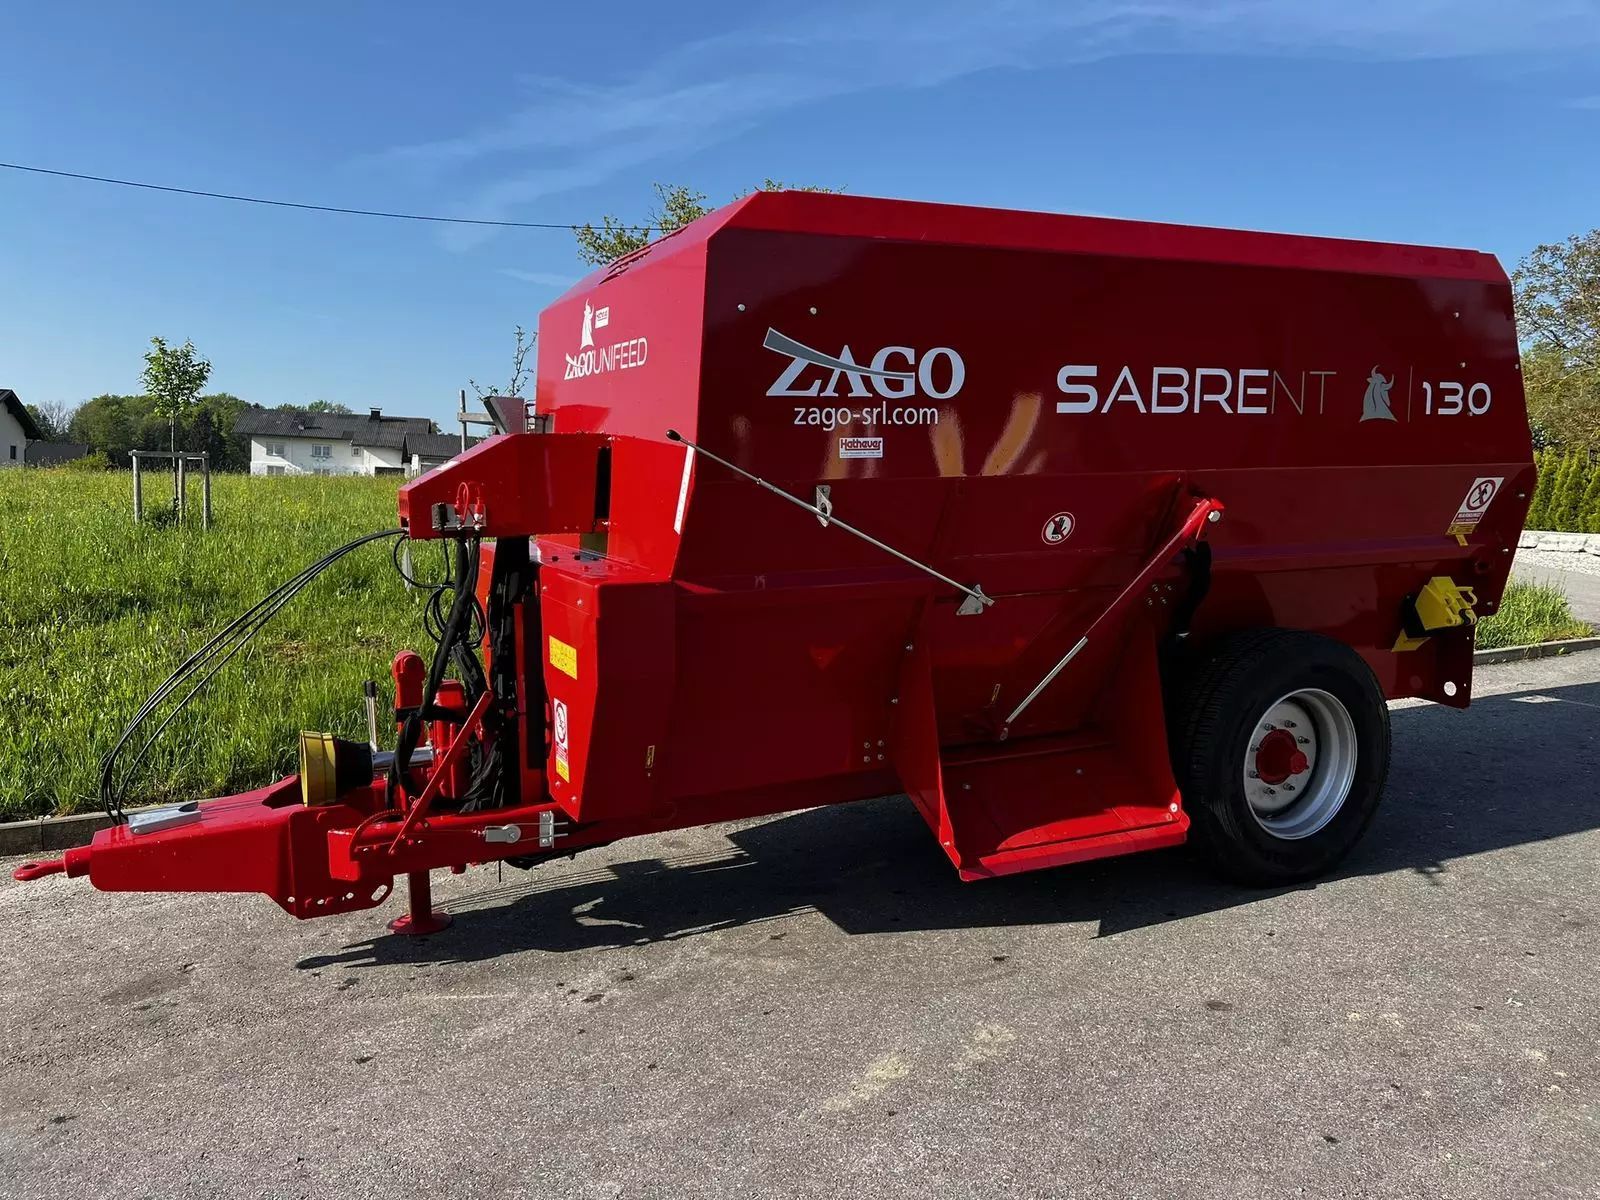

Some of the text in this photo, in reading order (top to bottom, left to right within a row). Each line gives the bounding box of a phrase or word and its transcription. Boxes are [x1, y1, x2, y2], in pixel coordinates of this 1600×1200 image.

[763, 327, 966, 399] ZAGO
[1056, 365, 1492, 415] SABRENT 130
[794, 401, 939, 431] zago-srl.com
